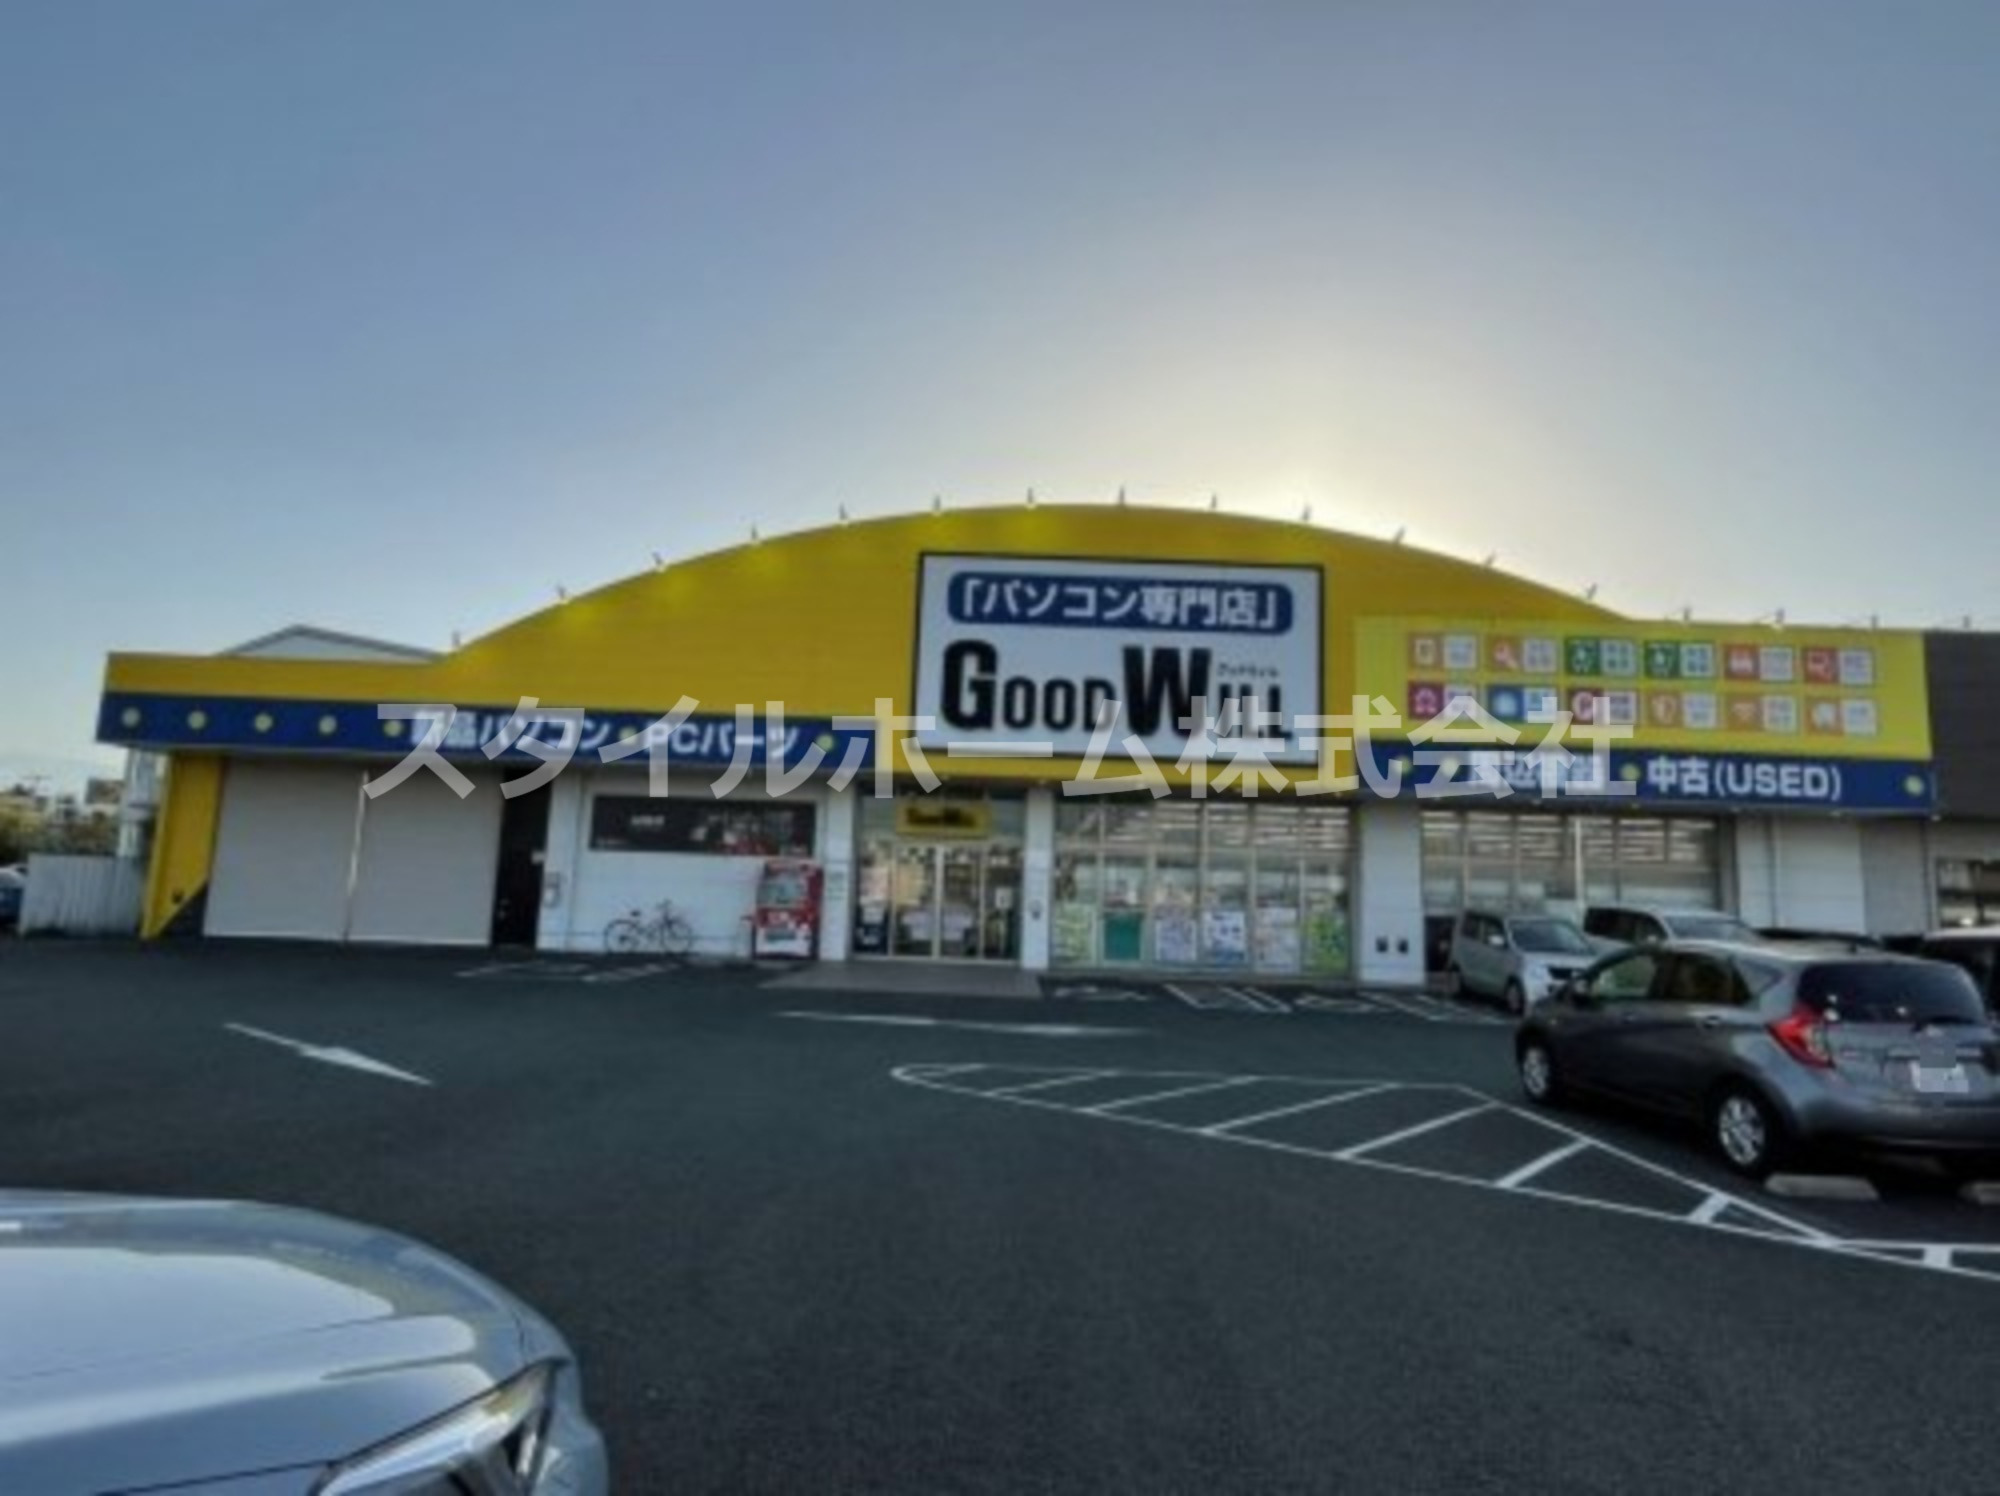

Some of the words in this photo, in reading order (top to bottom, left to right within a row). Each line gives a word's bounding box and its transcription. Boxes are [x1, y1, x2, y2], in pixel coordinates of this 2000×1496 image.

[964, 578, 1277, 628] 「パソコン専門店」
[1647, 755, 1841, 801] 中古(USED)
